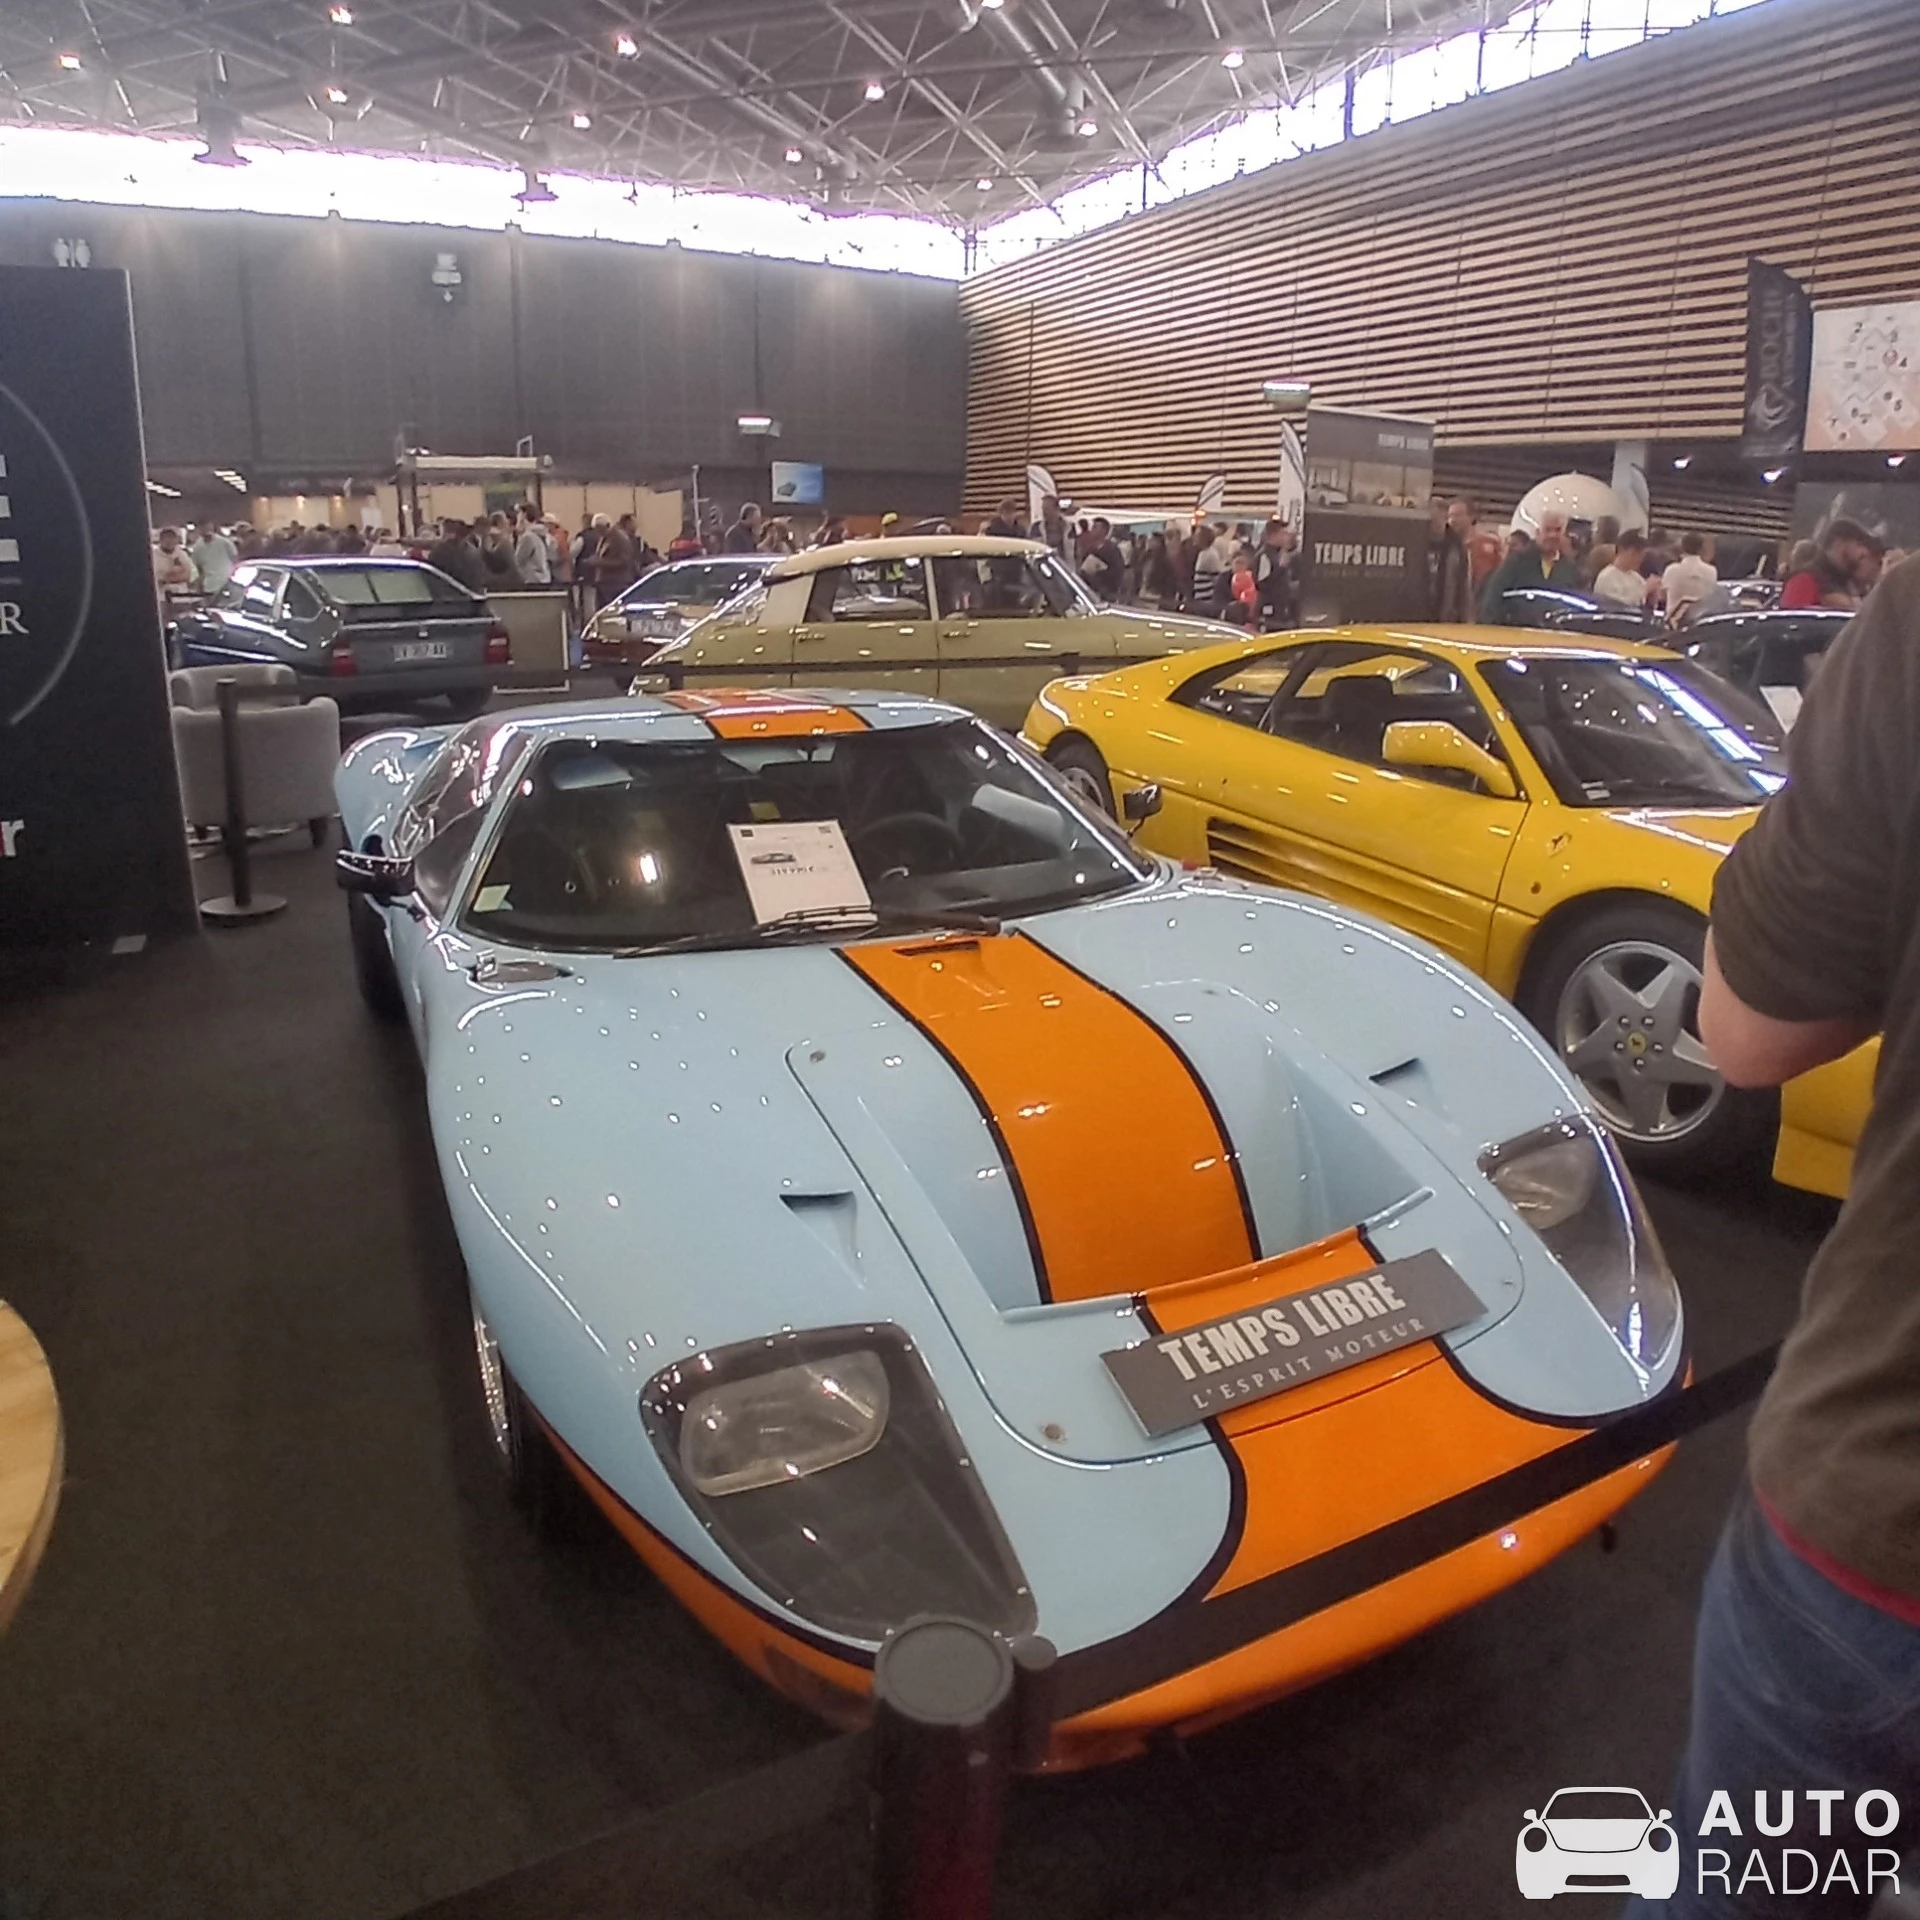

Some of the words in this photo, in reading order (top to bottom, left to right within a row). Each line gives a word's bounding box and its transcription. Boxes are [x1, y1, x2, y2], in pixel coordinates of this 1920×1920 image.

[1314, 542, 1362, 565] TEMPS
[1157, 1306, 1301, 1381] TEMPS
[1295, 1273, 1406, 1337] LIBRE
[1191, 1355, 1312, 1410] L'ESPRIT
[1325, 1317, 1426, 1363] MOTEUR
